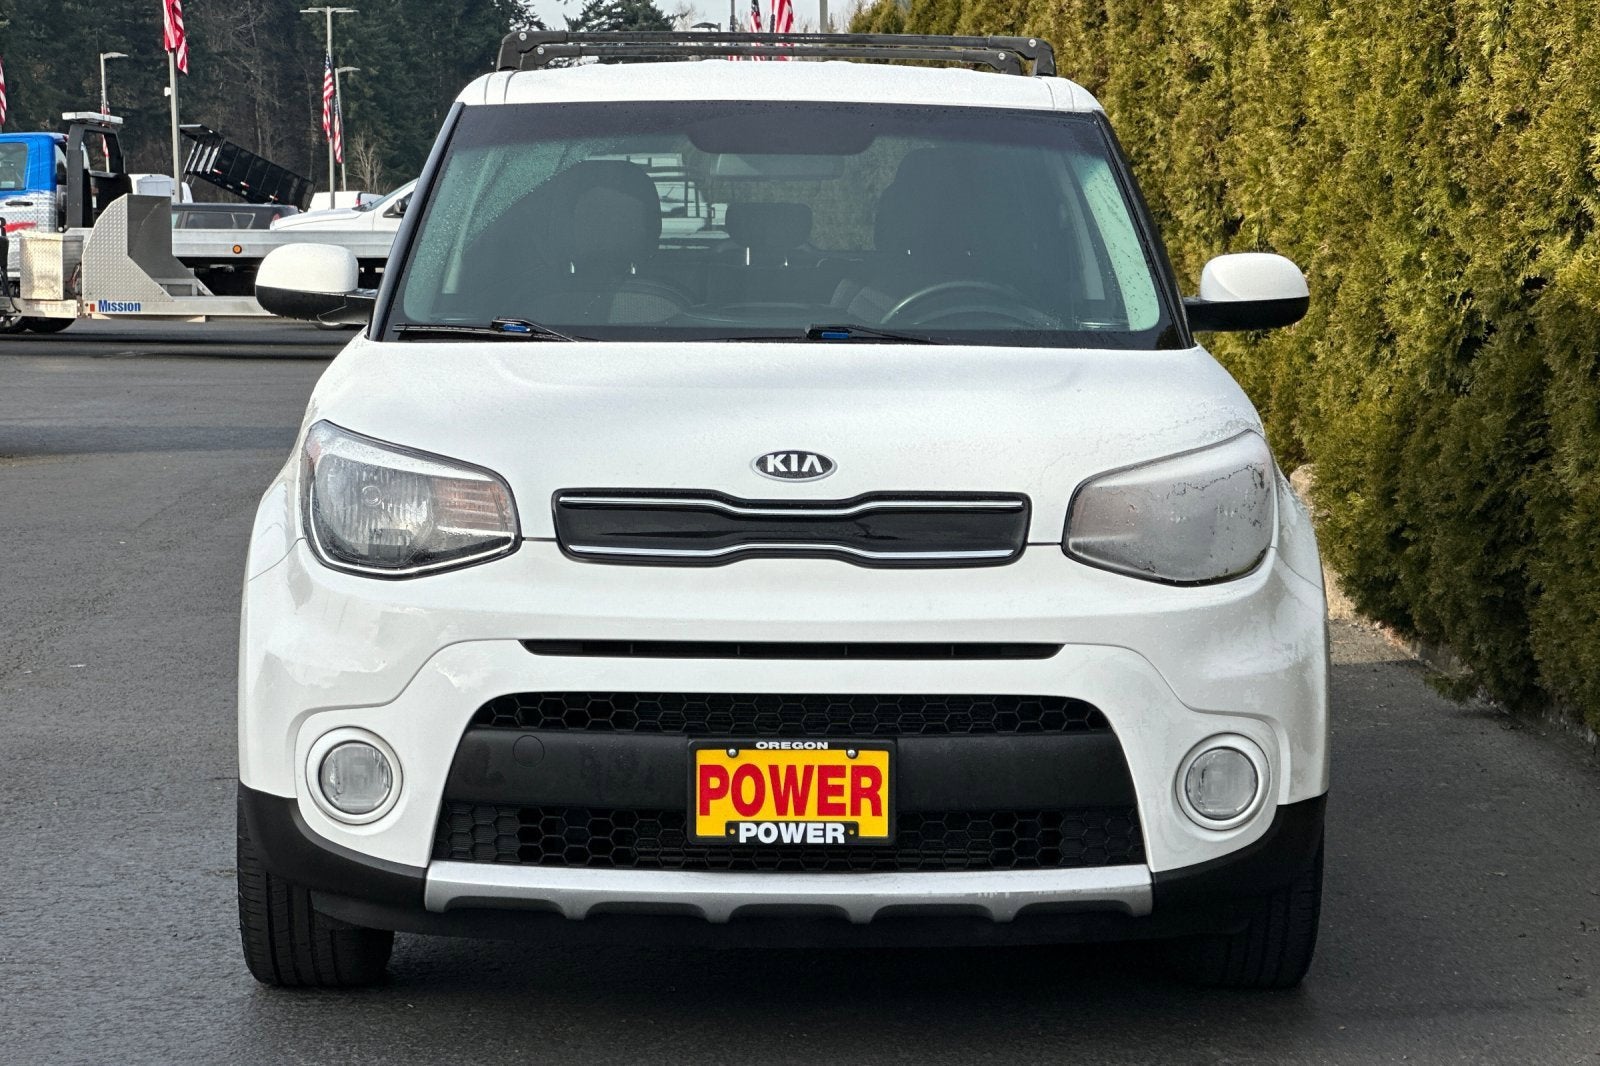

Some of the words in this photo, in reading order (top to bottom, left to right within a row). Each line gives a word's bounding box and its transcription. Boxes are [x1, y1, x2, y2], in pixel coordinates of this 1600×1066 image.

[765, 454, 823, 473] KIA
[755, 741, 829, 750] OREGON
[699, 763, 883, 817] POWER
[739, 822, 845, 843] POWER
